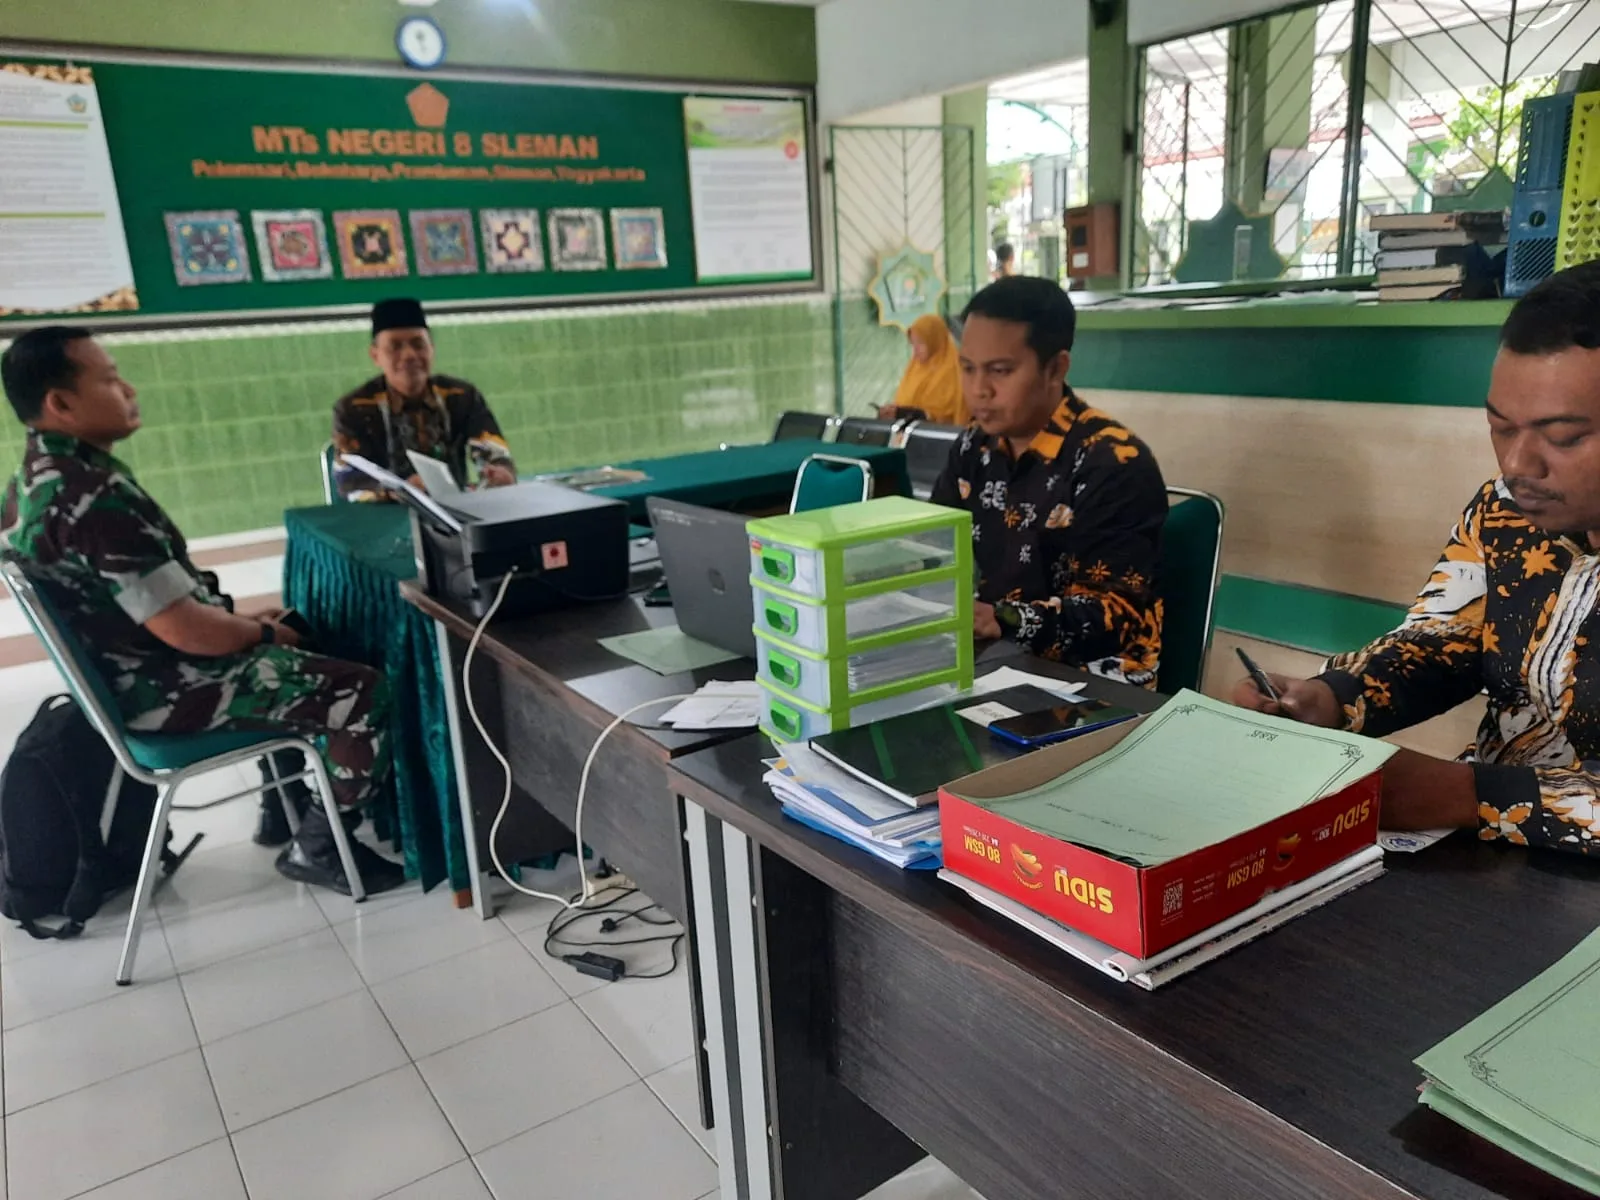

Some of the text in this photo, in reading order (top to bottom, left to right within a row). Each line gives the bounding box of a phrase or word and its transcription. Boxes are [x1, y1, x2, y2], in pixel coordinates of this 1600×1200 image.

[252, 125, 320, 155] MTs
[326, 128, 447, 157] NEGERI
[481, 132, 599, 160] SLEMAN
[963, 834, 1001, 864] 80 GSM
[1226, 865, 1250, 890] GSM
[1251, 858, 1265, 876] 80
[1053, 870, 1114, 915] SiDU
